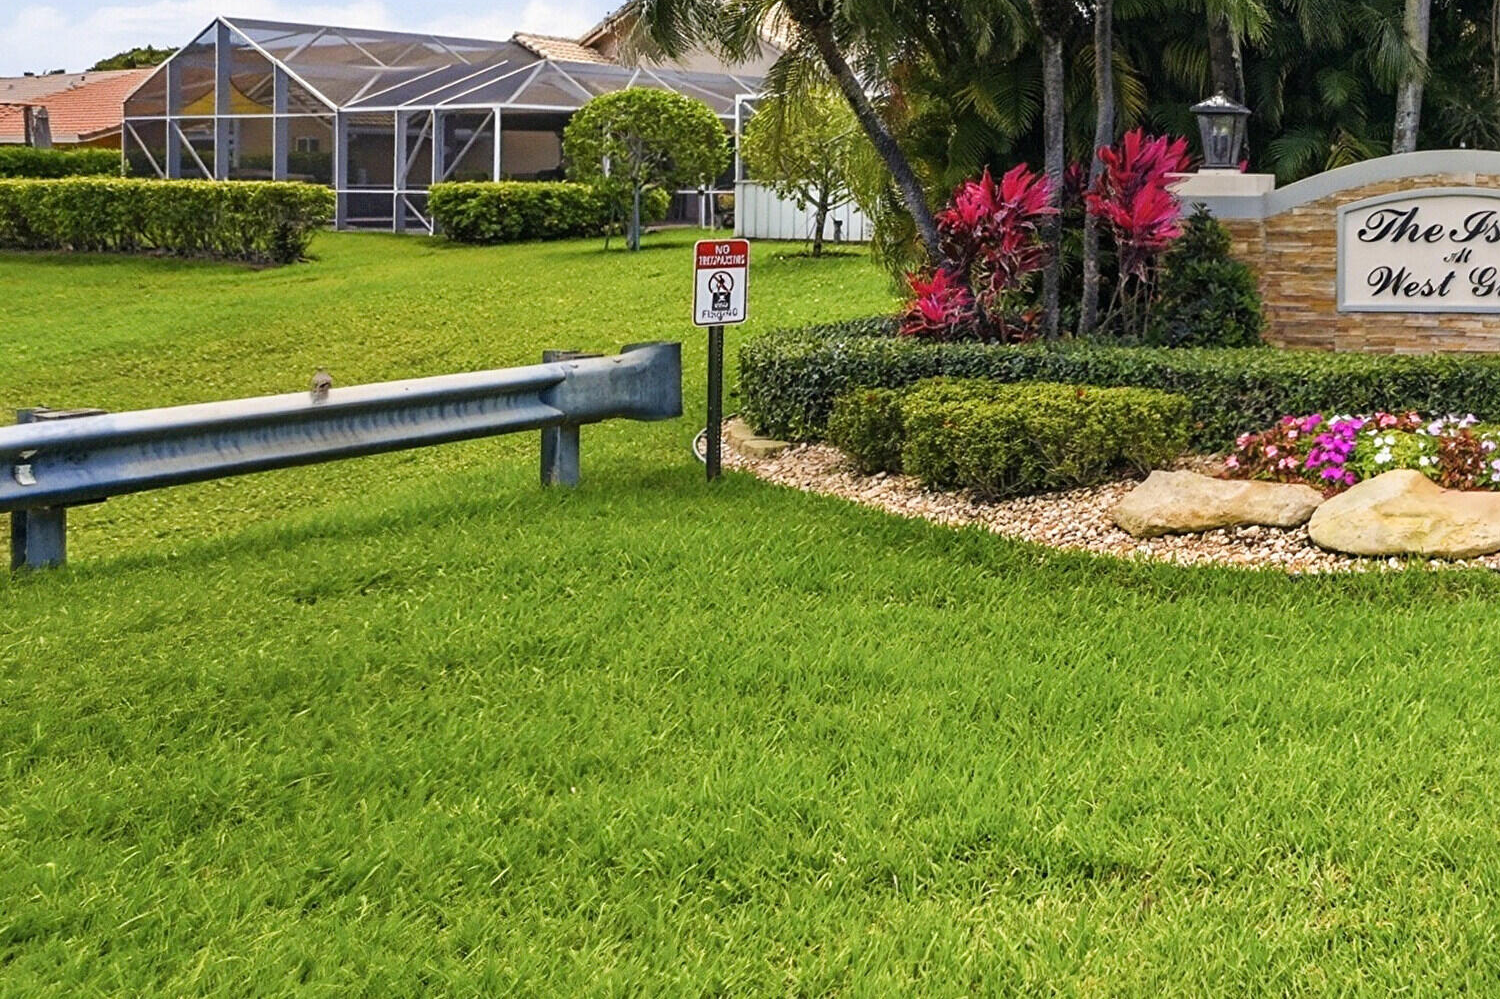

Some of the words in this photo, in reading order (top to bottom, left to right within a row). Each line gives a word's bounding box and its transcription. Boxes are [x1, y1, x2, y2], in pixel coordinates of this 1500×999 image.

[1357, 206, 1444, 243] The
[714, 244, 730, 254] NO
[1367, 266, 1455, 297] West
